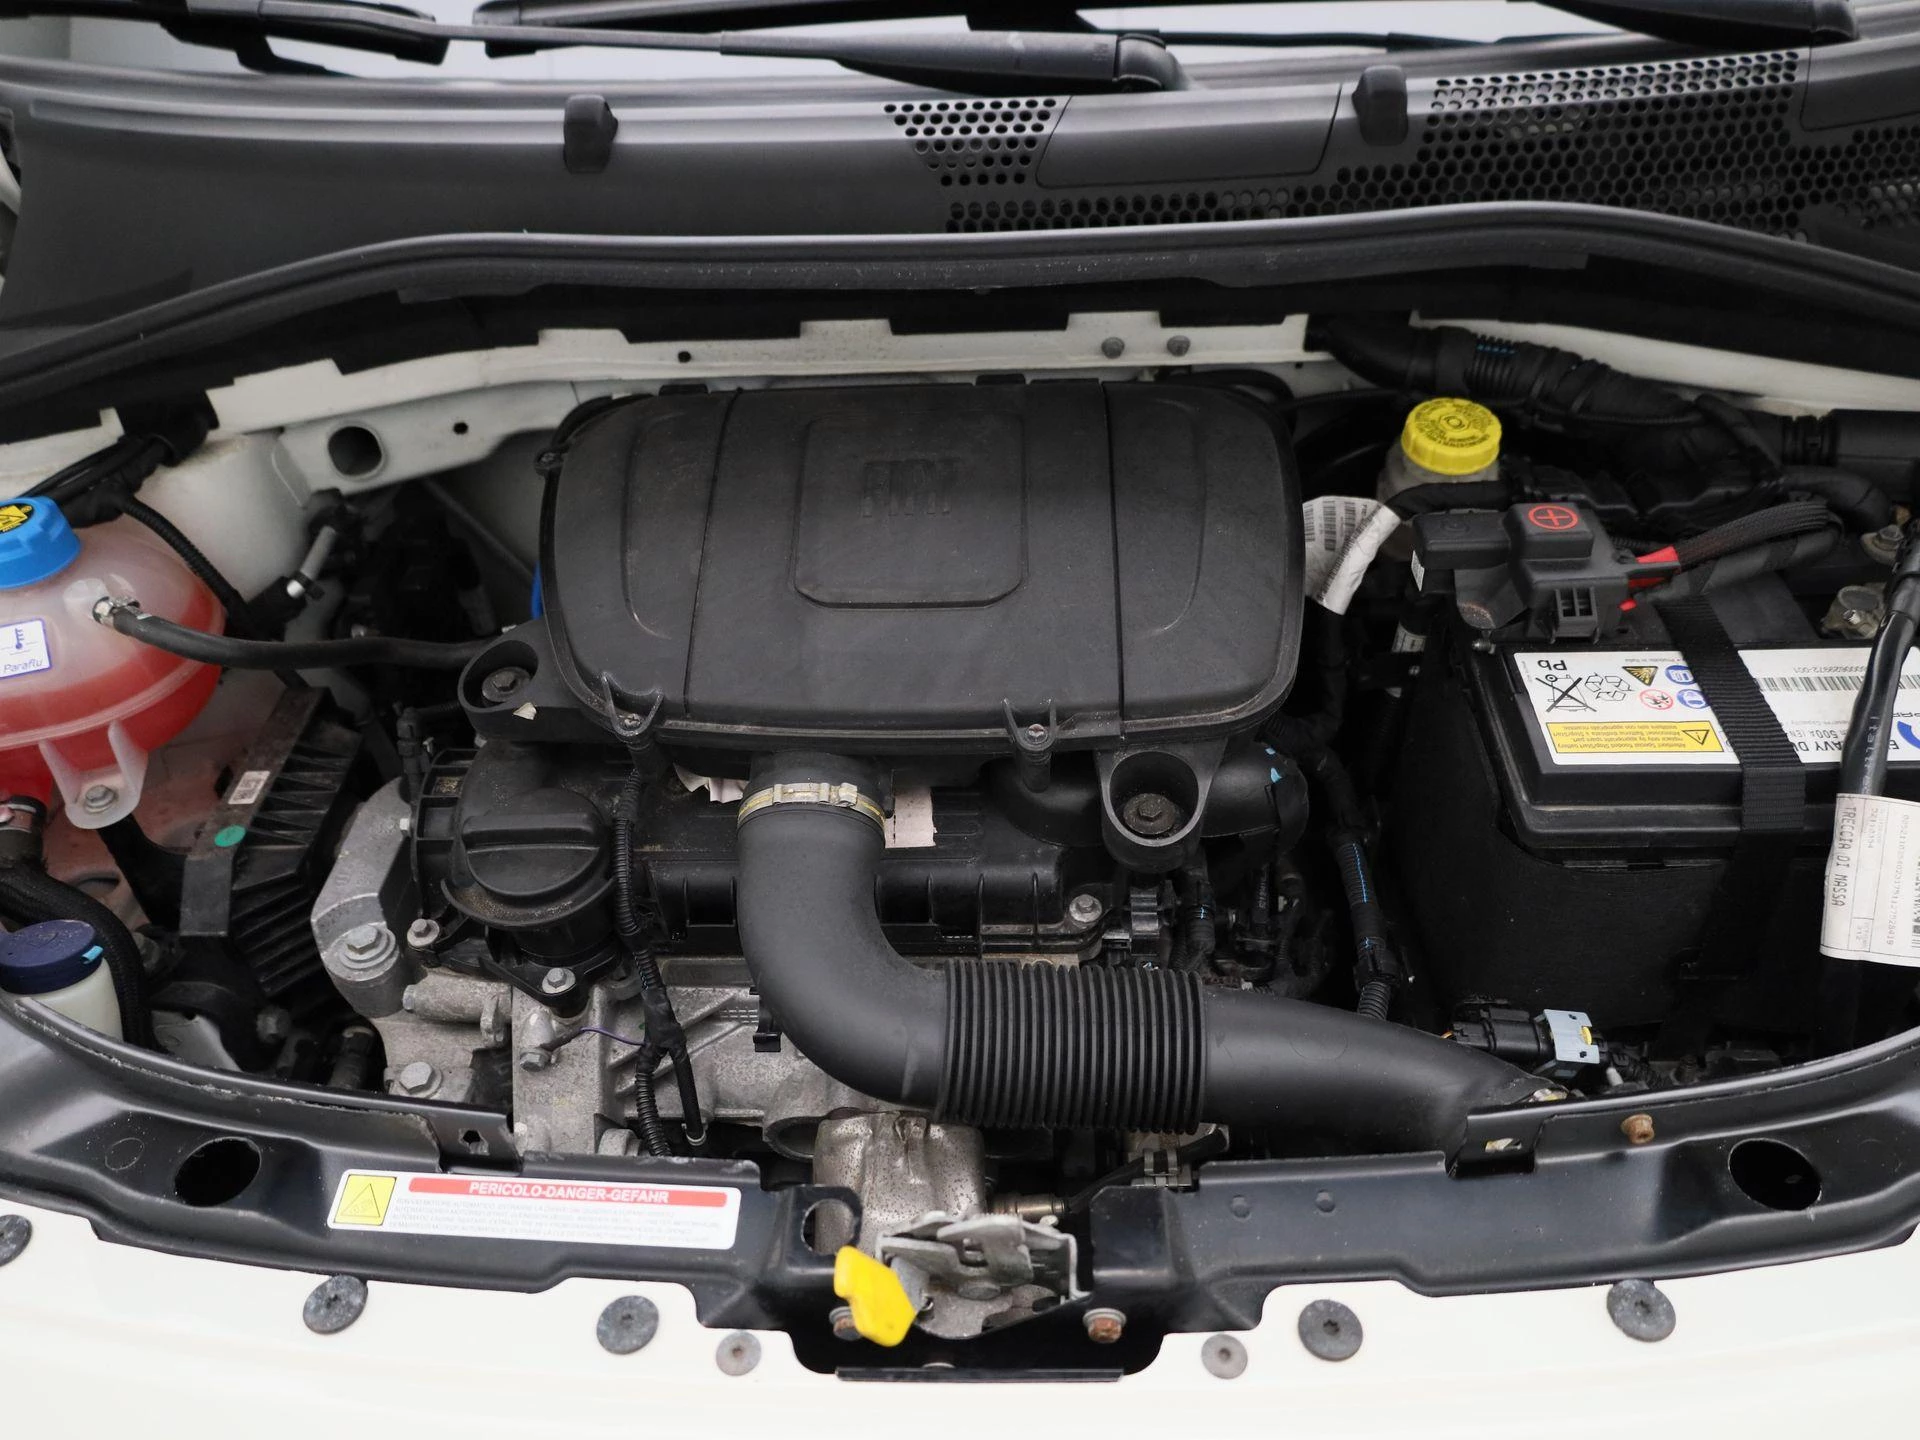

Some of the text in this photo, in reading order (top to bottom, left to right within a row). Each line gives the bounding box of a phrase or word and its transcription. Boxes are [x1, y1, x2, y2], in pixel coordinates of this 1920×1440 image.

[1536, 659, 1567, 671] Pb
[1813, 741, 1844, 752] AVY
[1831, 806, 1857, 907] TRECCIA DI MASSA
[469, 1181, 670, 1204] PERICOLO-DANGER-GEFAHR
